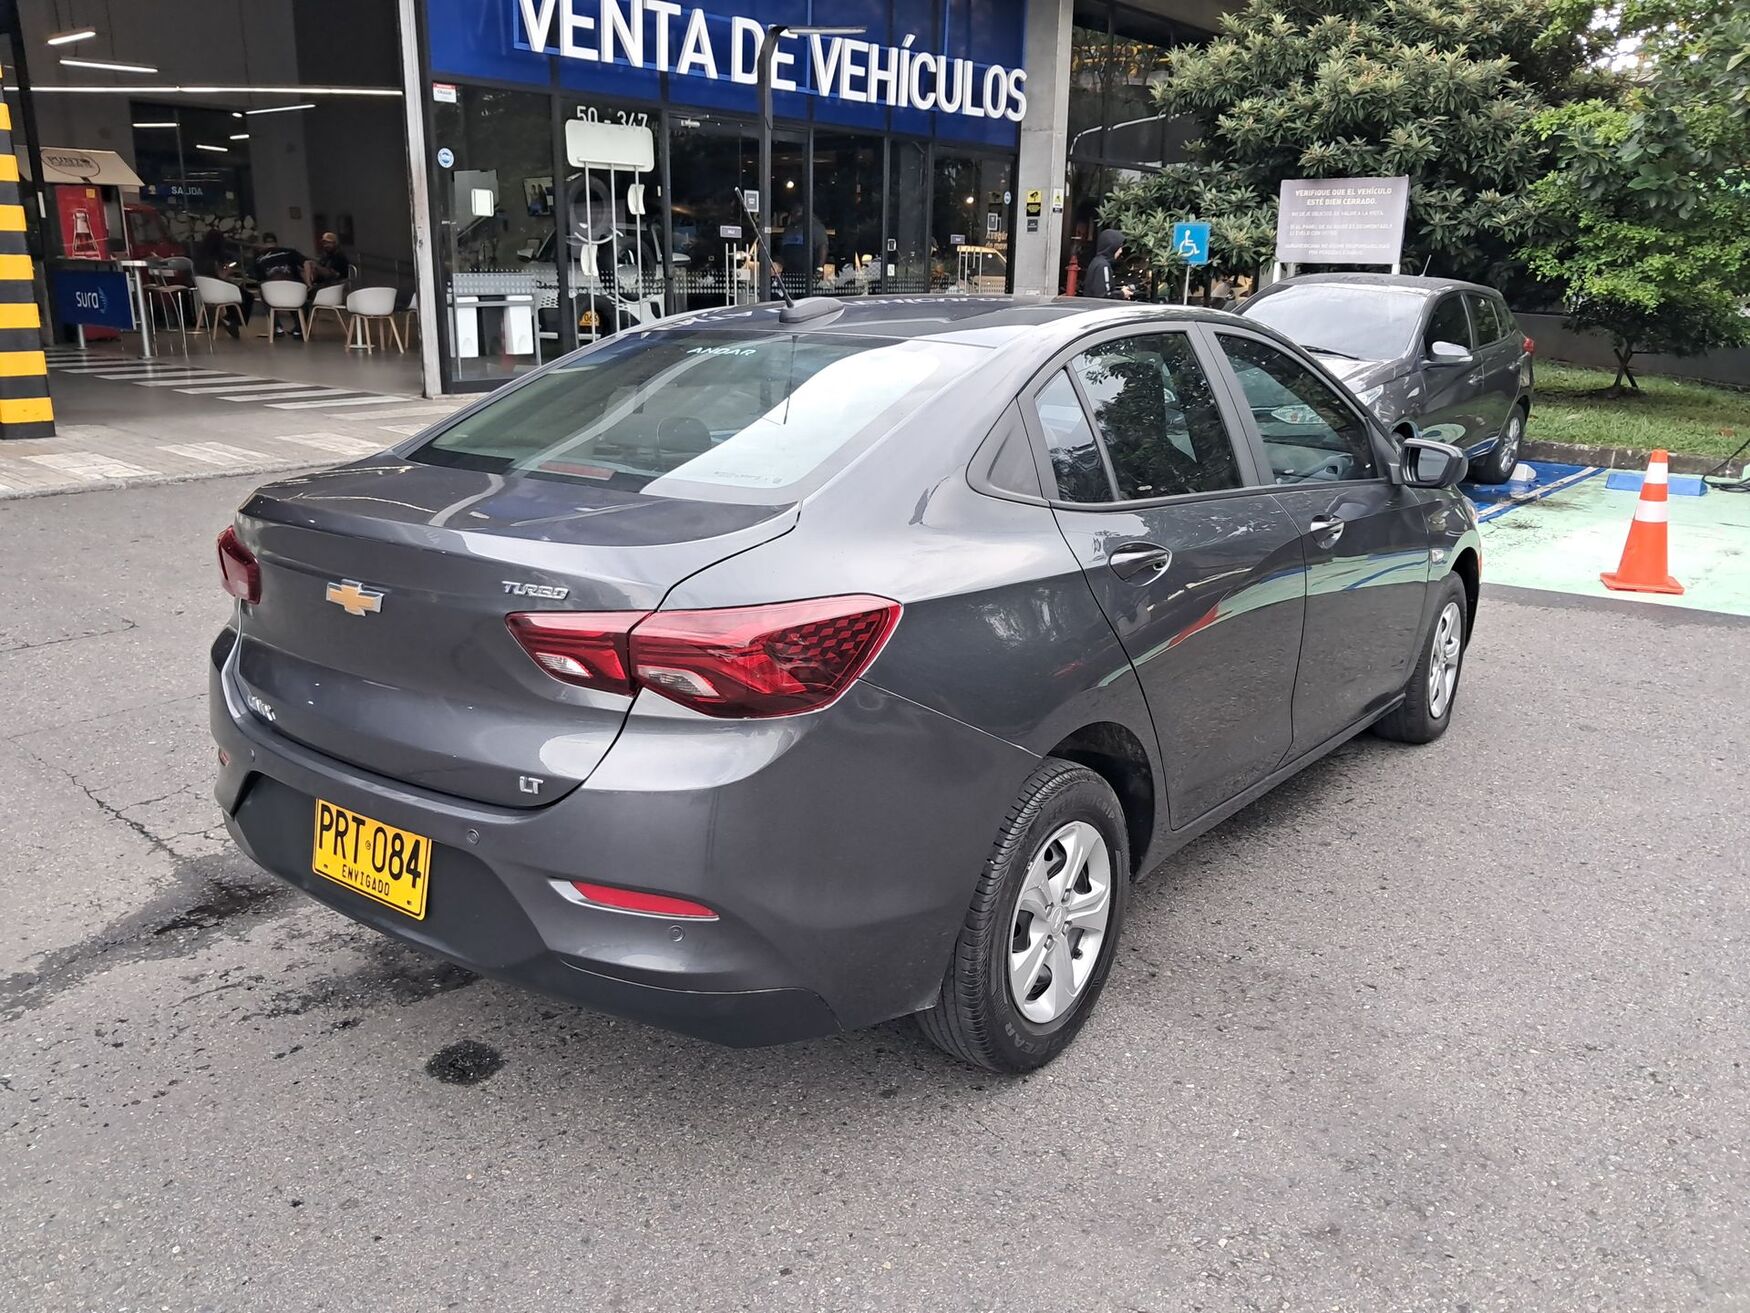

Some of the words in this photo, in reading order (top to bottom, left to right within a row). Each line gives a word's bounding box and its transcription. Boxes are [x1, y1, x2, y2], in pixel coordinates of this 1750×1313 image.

[519, 0, 718, 80] VENTA
[731, 16, 798, 92] DE
[809, 33, 1028, 122] VEHÍCULOS
[576, 105, 599, 123] 50
[1295, 189, 1331, 197] VERIFIQUE
[75, 291, 100, 309] sura
[686, 347, 757, 356] ANDAR
[502, 580, 570, 600] TURBO
[519, 775, 544, 795] LT
[317, 804, 366, 865] PRT
[371, 826, 422, 889] 084
[341, 863, 391, 897] ENVIGADO
